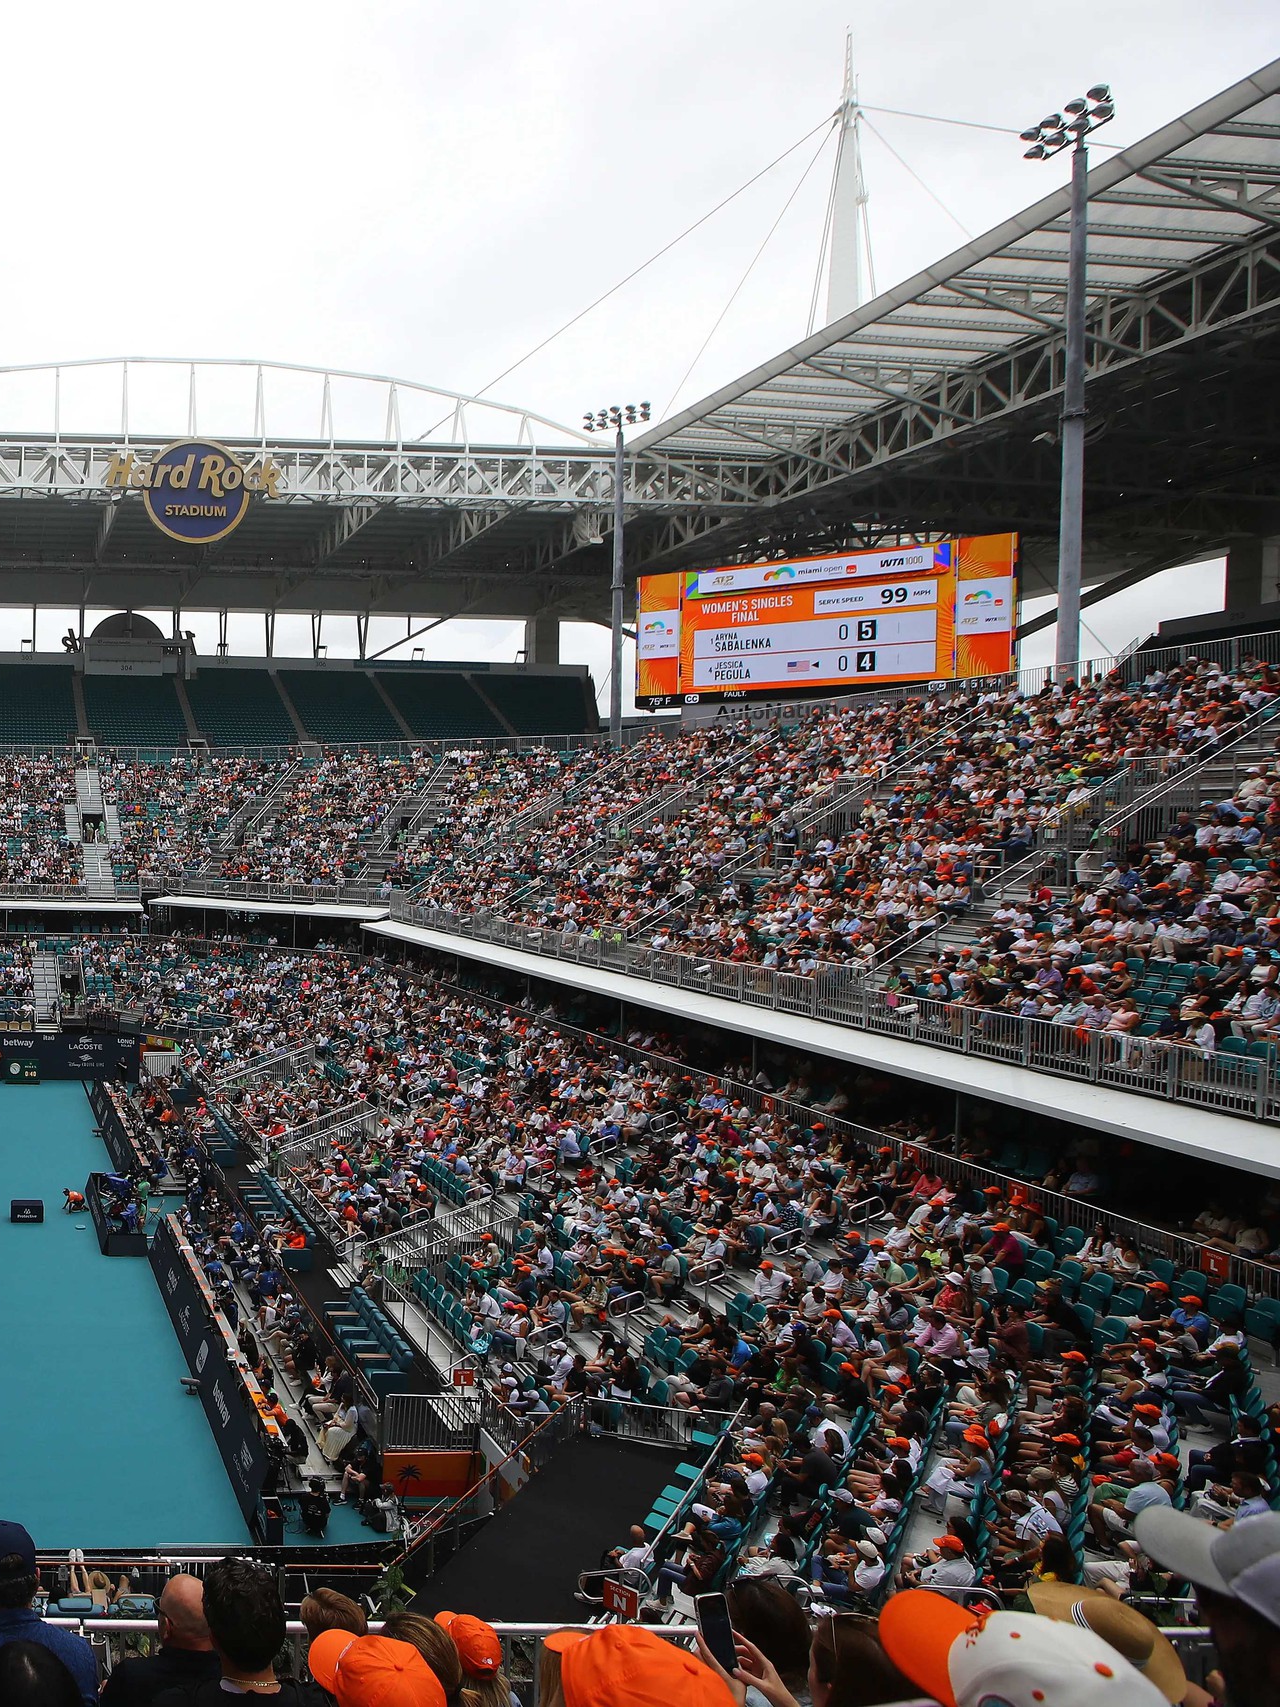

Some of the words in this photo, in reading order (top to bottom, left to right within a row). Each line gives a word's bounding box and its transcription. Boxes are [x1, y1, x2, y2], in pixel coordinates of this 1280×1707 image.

[106, 453, 196, 490] Hard
[198, 454, 282, 499] Rock
[165, 504, 227, 517] STADIUM
[798, 567, 823, 575] miami
[881, 587, 908, 605] 99
[913, 589, 931, 597] MPH
[701, 600, 749, 614] WOMEN'S
[751, 596, 793, 610] SINGLES
[818, 597, 841, 606] SERVE
[842, 595, 863, 604] SPEED
[731, 611, 760, 624] FINAL
[715, 632, 738, 641] ARYNA
[839, 624, 848, 640] 0
[861, 622, 872, 639] 5
[714, 637, 772, 652] SABALENKA
[714, 660, 743, 670] JESSICA
[838, 655, 848, 671] 0
[860, 653, 871, 670] 4
[714, 668, 751, 681] PEGULA
[959, 679, 983, 689] 451
[686, 695, 699, 703] CC
[723, 690, 747, 698] FAULT.
[716, 701, 838, 723] AutoNation
[3, 1038, 34, 1048] betway
[764, 1100, 770, 1110] K
[1206, 1250, 1223, 1261] SECTION
[1209, 1258, 1218, 1272] L
[461, 1375, 467, 1385] L
[212, 1379, 231, 1429] betway
[610, 1585, 631, 1598] SECTION
[613, 1593, 627, 1612] N
